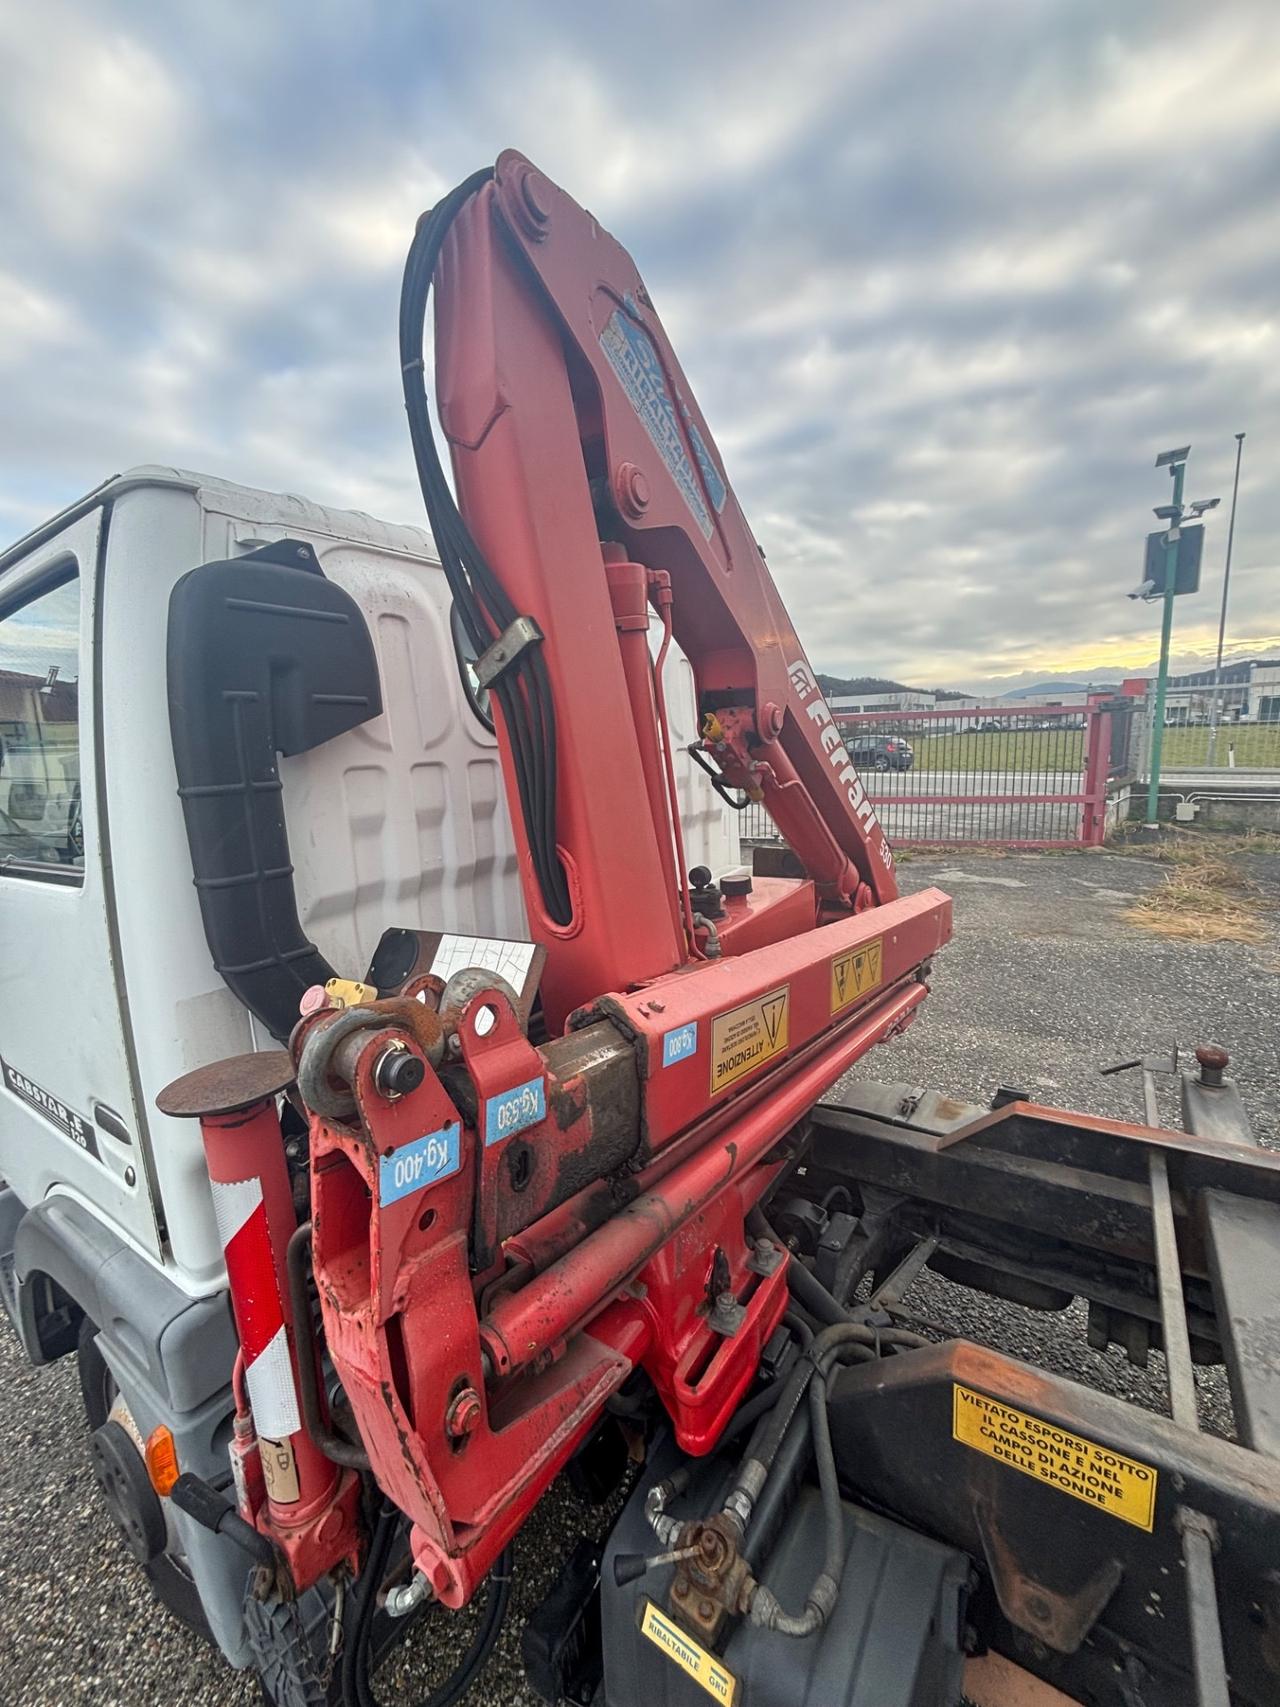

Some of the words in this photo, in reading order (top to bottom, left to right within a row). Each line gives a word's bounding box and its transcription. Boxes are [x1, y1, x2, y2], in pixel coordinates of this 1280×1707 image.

[717, 1040, 764, 1078] ATTENZIONE
[70, 1127, 87, 1148] 120
[395, 1138, 448, 1188] Kg.400
[960, 1391, 1019, 1424] VIETATO
[1025, 1420, 1088, 1455] ESPORSI
[1094, 1450, 1149, 1481] SOTTO
[980, 1426, 1033, 1456] CAMPO
[1038, 1452, 1055, 1467] DI
[1059, 1463, 1124, 1499] AZIONE
[983, 1414, 995, 1427] IL
[1000, 1423, 1070, 1460] CASSONE
[1076, 1455, 1085, 1467] E
[1090, 1462, 1121, 1485] NEL
[993, 1444, 1036, 1471] DELLE
[1041, 1467, 1106, 1504] SPONDE
[649, 1622, 700, 1672] RIBALTABILE
[709, 1676, 727, 1697] GRU
